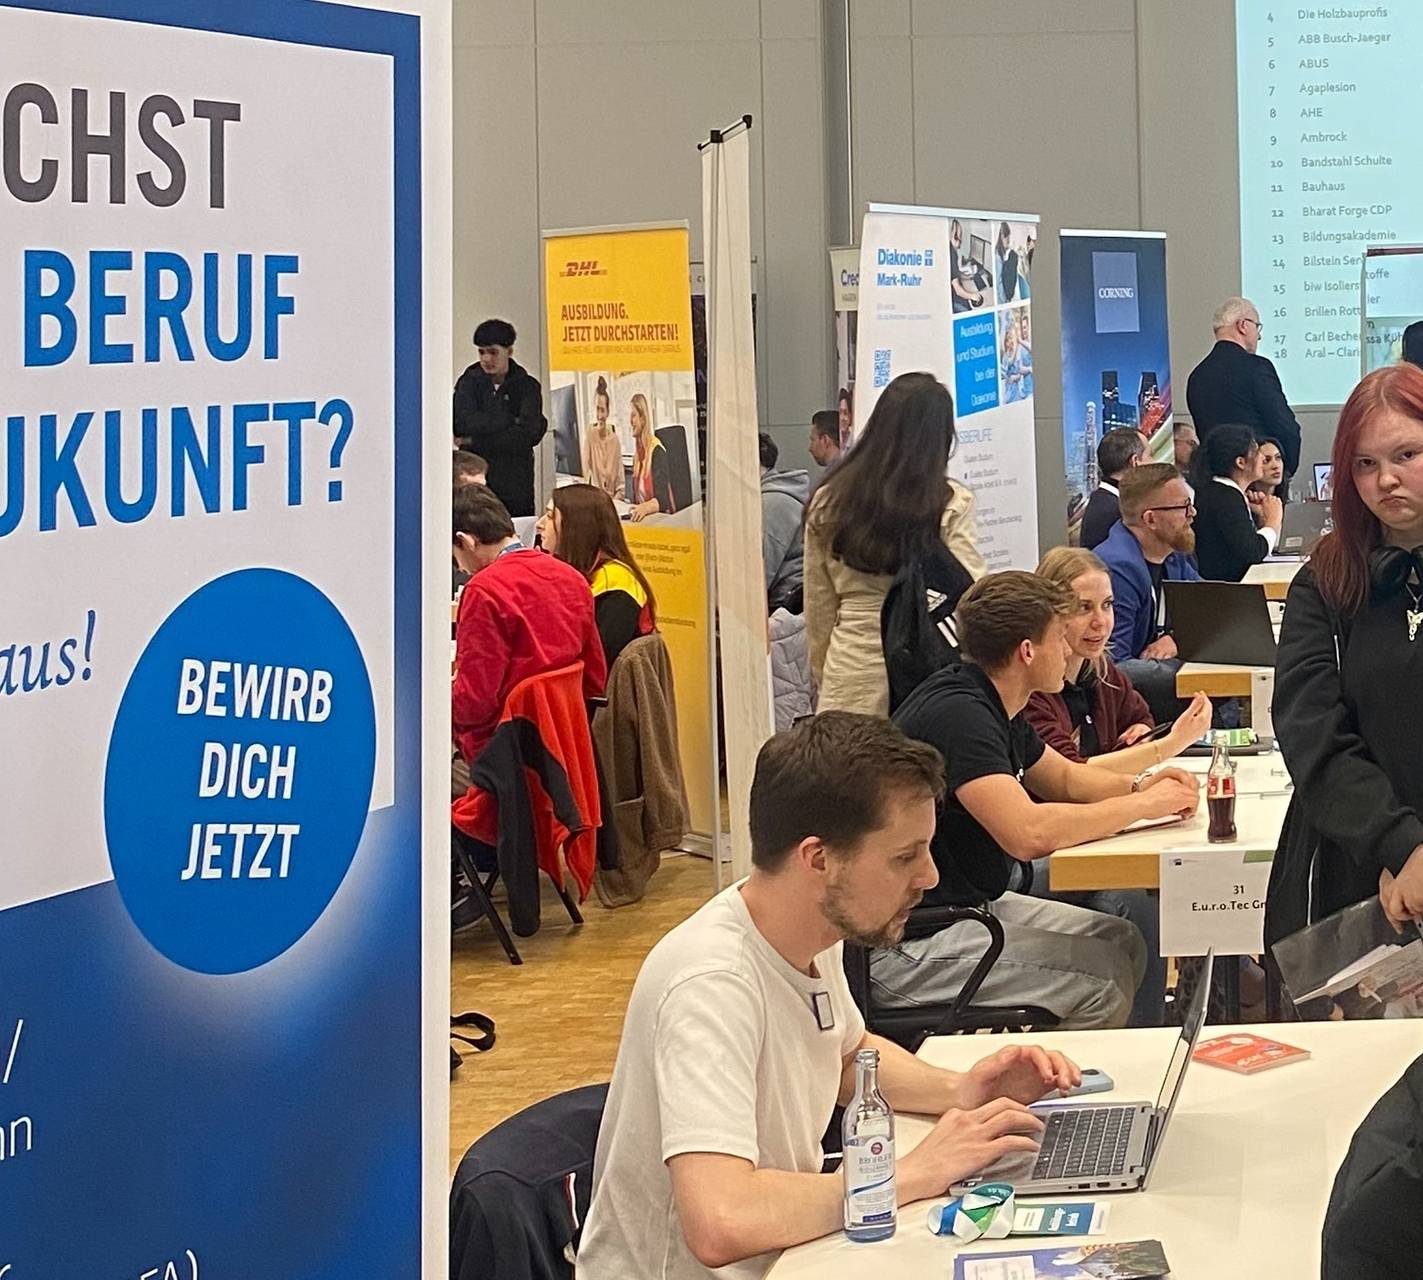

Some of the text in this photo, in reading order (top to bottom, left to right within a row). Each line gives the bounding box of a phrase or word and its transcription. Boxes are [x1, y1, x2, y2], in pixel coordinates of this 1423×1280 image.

[1267, 13, 1273, 23] 4
[1298, 7, 1388, 20] Die Holzbauprofis
[1268, 36, 1274, 47] 5
[1298, 32, 1391, 46] ABB Busch-Jaeger
[1269, 59, 1275, 70] 6
[1299, 58, 1329, 69] ABUS
[1269, 86, 1275, 97] 7
[1299, 82, 1356, 96] Agaplesion
[1270, 107, 1276, 118] 8
[1300, 108, 1323, 118] AHE
[1270, 135, 1277, 147] 9
[1300, 131, 1348, 143] Ambrock
[3, 83, 241, 209] CHST
[1301, 155, 1392, 167] Bandstahl Schulte
[1302, 181, 1346, 193] Bauhaus
[1272, 208, 1284, 217] 12
[1303, 205, 1393, 219] Bharat Forge CDP
[1272, 234, 1285, 245] 13
[1303, 229, 1397, 244] Bildungsakademie
[878, 248, 922, 266] Diakonie
[1304, 255, 1341, 267] Bilstein
[565, 261, 601, 277] DHL
[1273, 258, 1286, 270] 14
[877, 272, 922, 287] Mark-Ruhr
[1304, 280, 1360, 291] biw Isoliers
[1099, 287, 1134, 299] CORNING
[1273, 284, 1286, 295] 15
[24, 249, 299, 367] BERUF
[561, 303, 629, 320] AUSBILDUNG.
[1274, 307, 1287, 318] 16
[1305, 306, 1337, 317] Brillen
[563, 323, 679, 342] JETZT DURCHSTARTEN!
[1305, 331, 1361, 342] Carl Beche
[1274, 334, 1286, 345] 17
[1274, 348, 1287, 359] 18
[1305, 347, 1326, 357] Aral
[176, 658, 334, 723] BEWIRB
[199, 742, 297, 799] DICH
[181, 823, 301, 880] JETZT
[1233, 885, 1244, 894] 31
[1191, 900, 1249, 911] E.u.r.o.Tec
